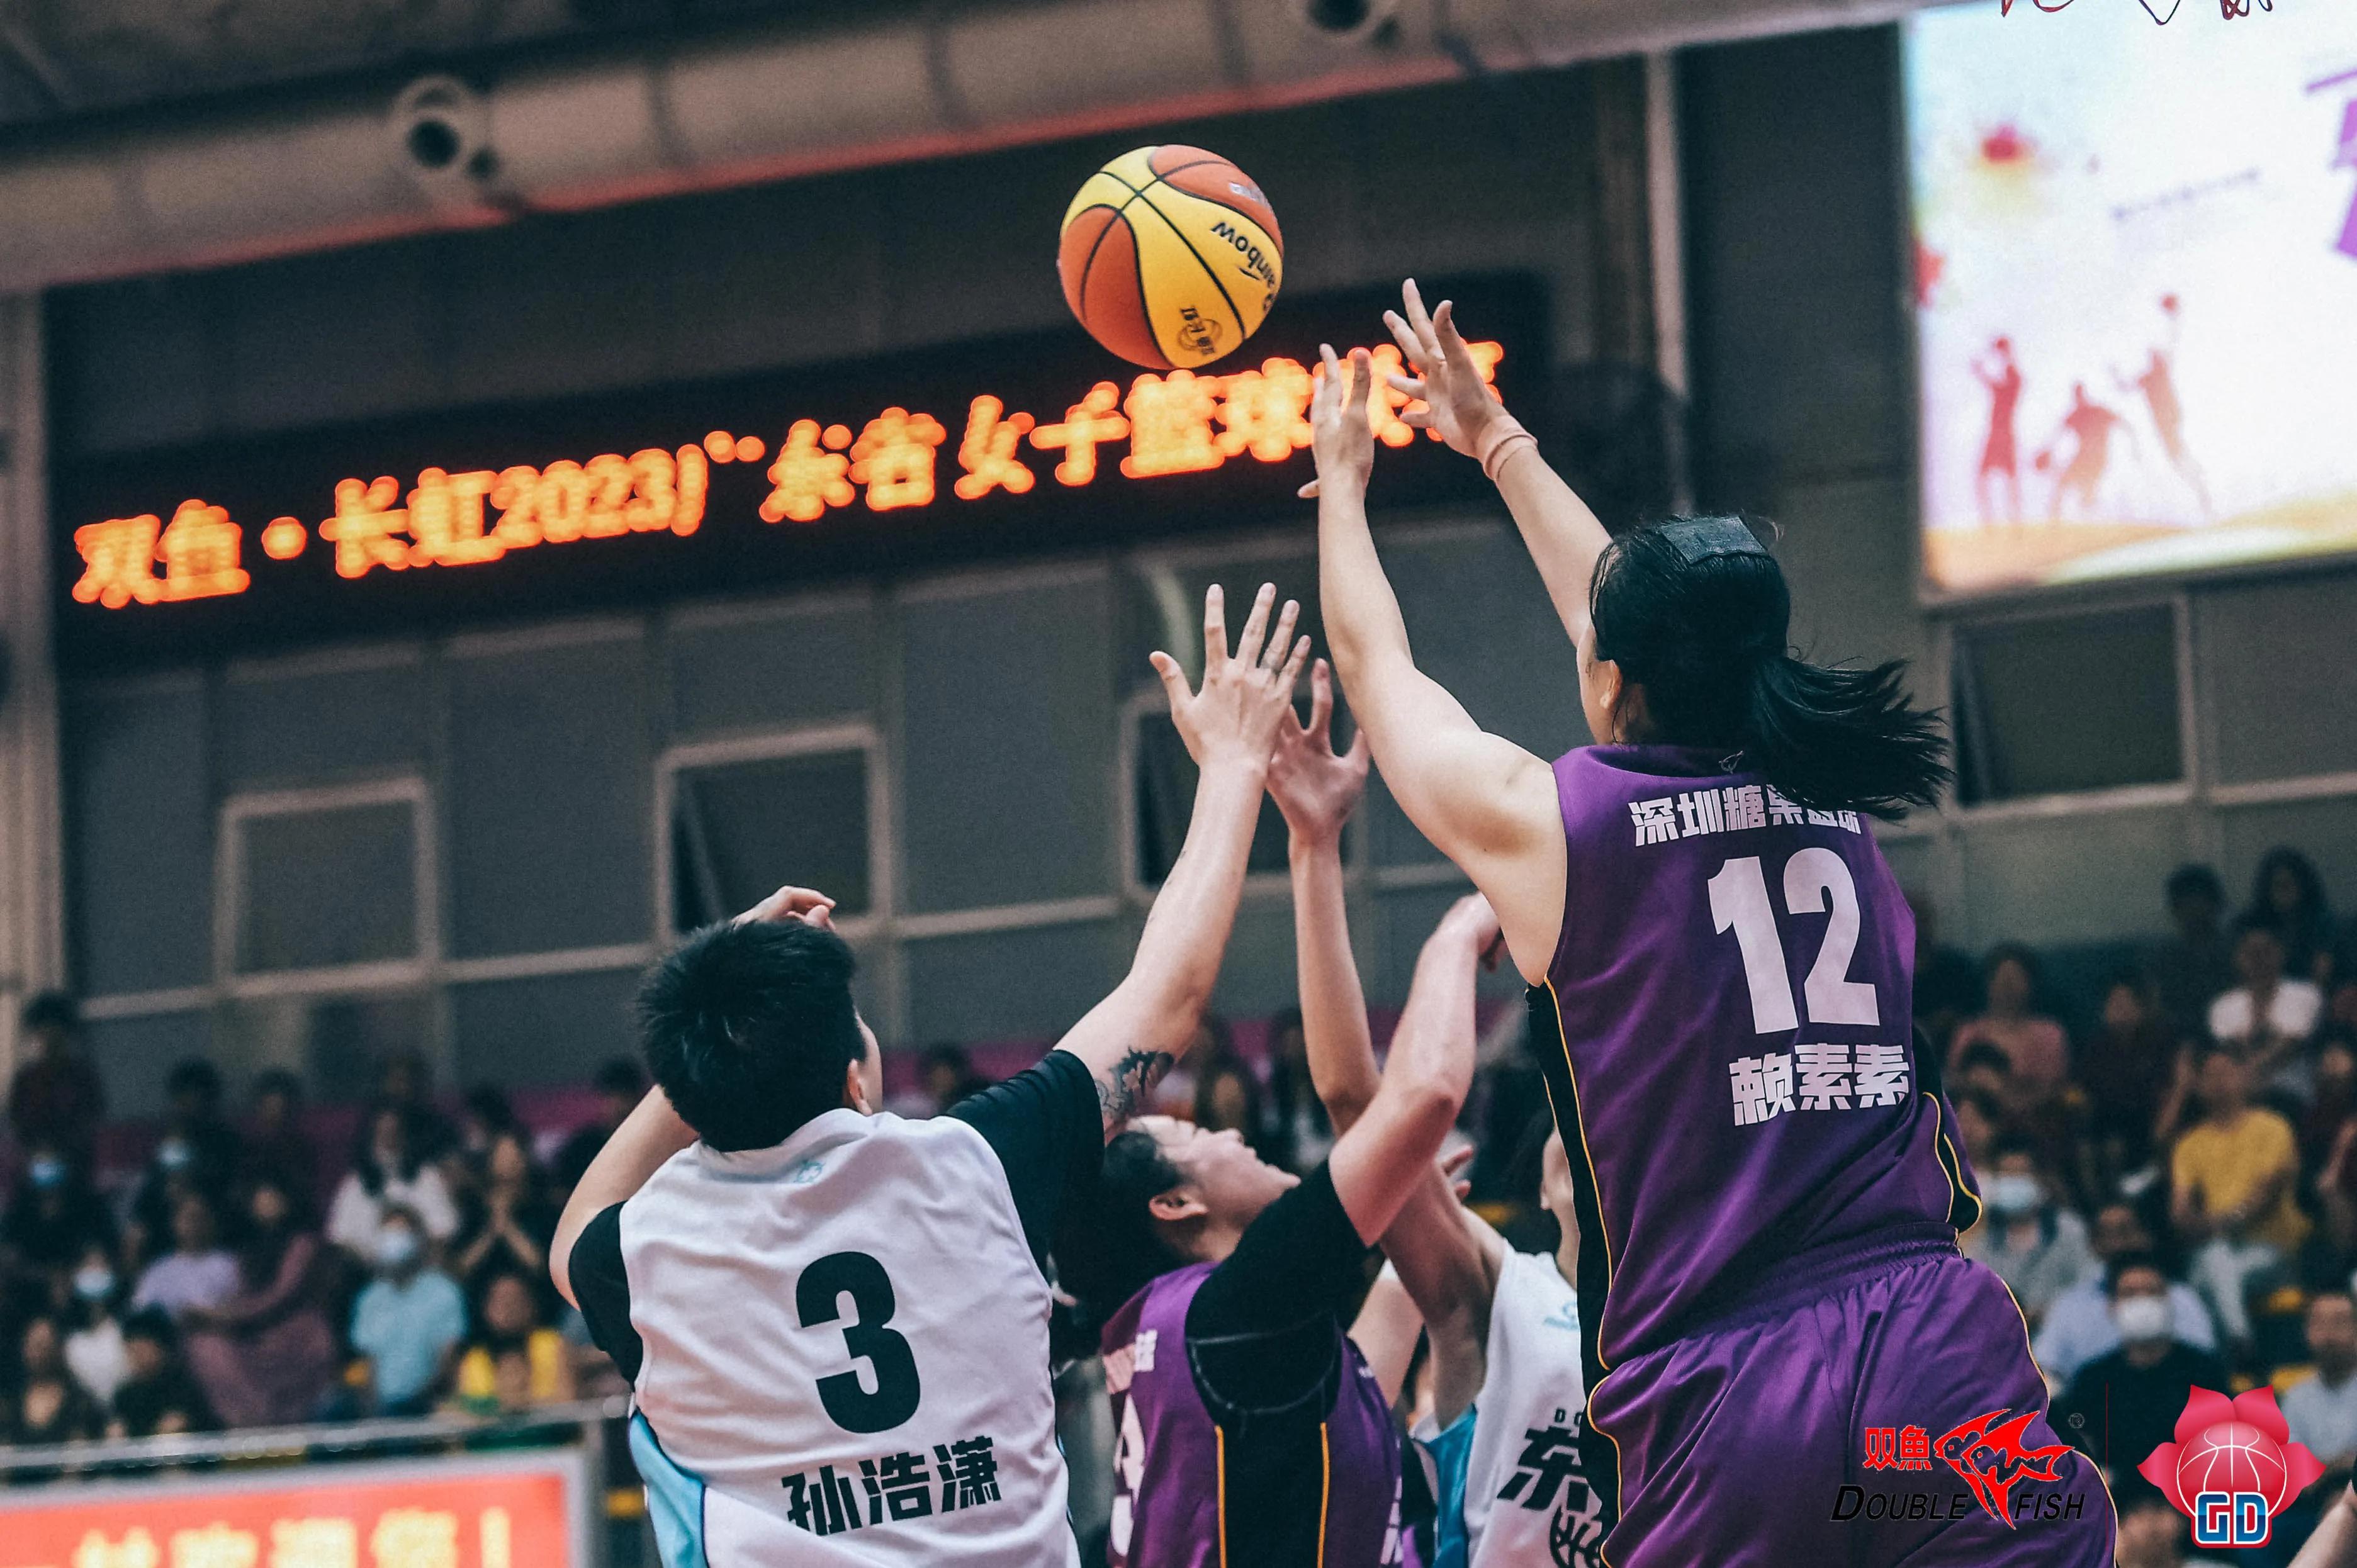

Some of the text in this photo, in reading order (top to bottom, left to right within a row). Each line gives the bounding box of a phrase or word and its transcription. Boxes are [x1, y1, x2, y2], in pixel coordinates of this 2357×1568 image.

[1707, 847, 1880, 1034] 12
[1729, 1043, 1910, 1126] 赖素素
[796, 1251, 921, 1434] 3
[781, 1435, 1002, 1537] 孙浩潇
